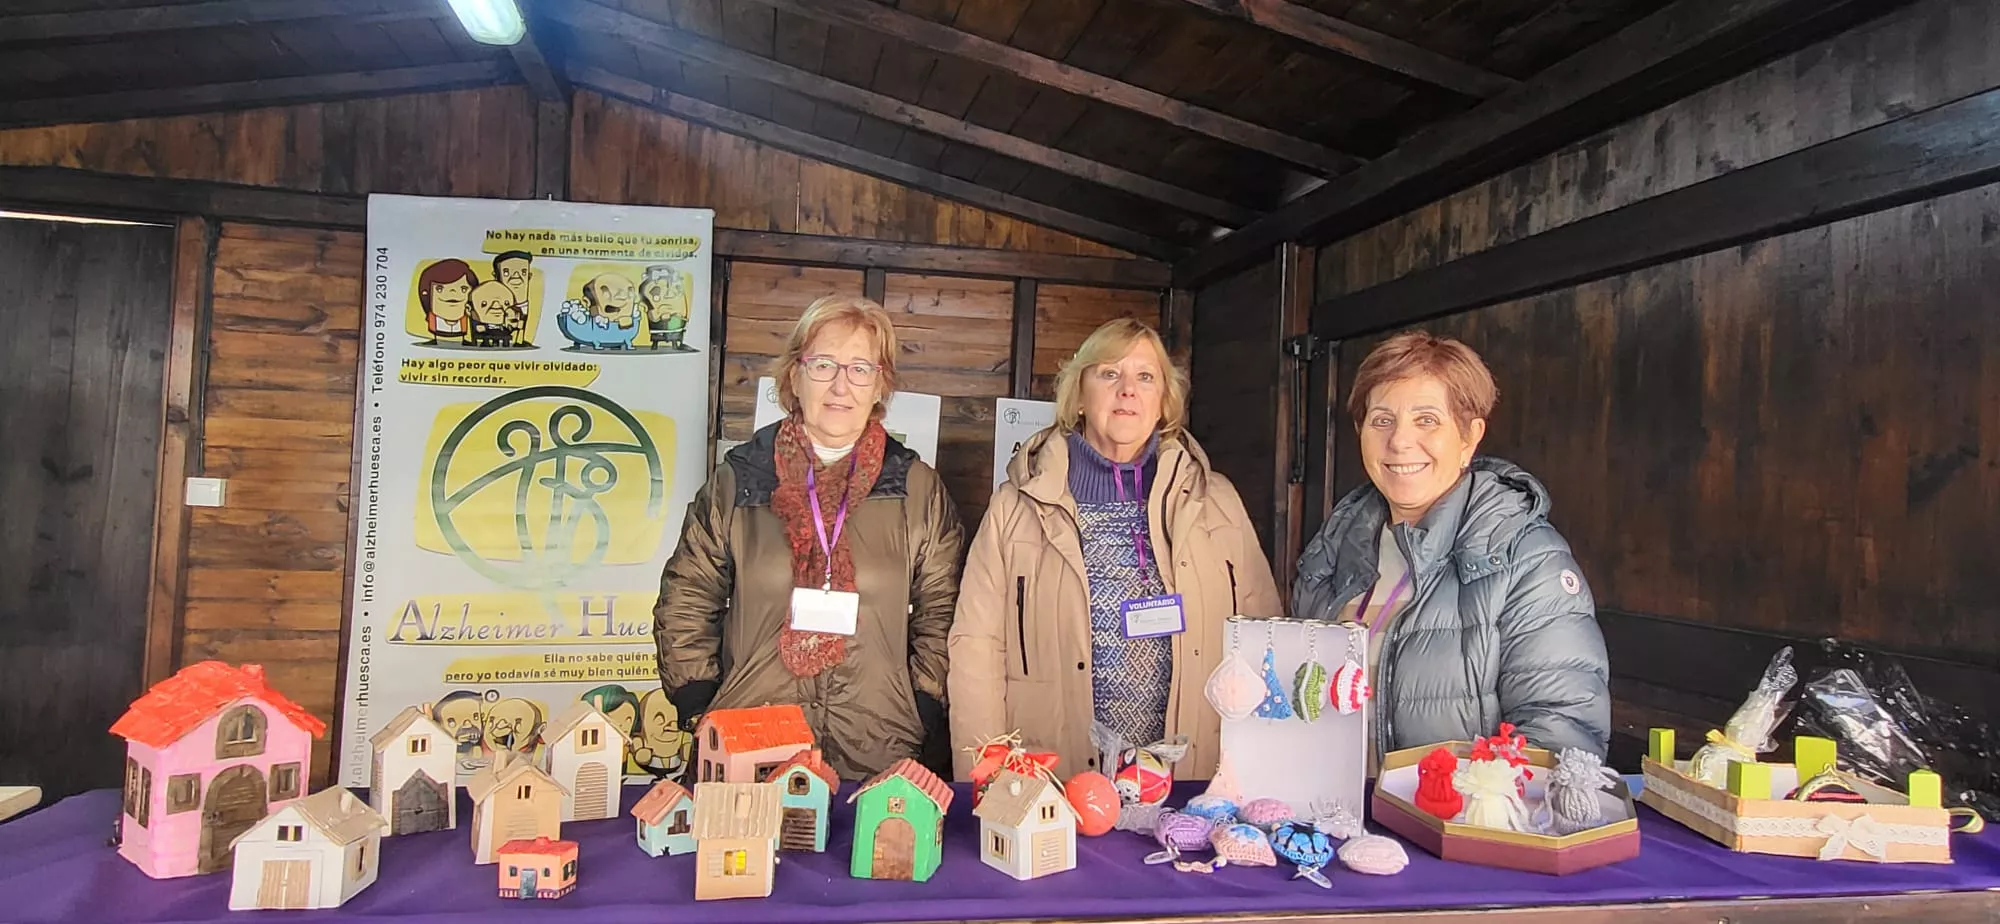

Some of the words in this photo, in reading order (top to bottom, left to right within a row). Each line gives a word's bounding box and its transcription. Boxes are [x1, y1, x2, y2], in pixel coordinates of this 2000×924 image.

[486, 230, 502, 240] No
[505, 231, 525, 242] hay
[529, 231, 556, 241] nada
[560, 233, 583, 243] más
[586, 234, 613, 244] bello
[617, 236, 637, 246] que
[655, 236, 698, 246] sonrisa,
[376, 247, 389, 271] 704
[541, 246, 555, 255] en
[559, 247, 579, 256] una
[582, 248, 635, 257] tormenta
[375, 275, 388, 300] 230
[374, 304, 386, 328] 974
[371, 332, 385, 394] Teléfono
[401, 358, 425, 369] Hay
[428, 359, 455, 371] algo
[458, 362, 485, 371] peor
[489, 363, 511, 372] que
[514, 361, 540, 371] vivir
[543, 361, 597, 372] olvidado:
[400, 372, 428, 382] vivir
[431, 372, 449, 382] sin
[452, 373, 507, 384] recordar.
[361, 415, 382, 603] info@alzheimerhuesca.es
[1128, 598, 1176, 610] VOLUNTARIO
[388, 598, 564, 642] Alzheimer
[577, 595, 650, 637] Hue
[544, 653, 565, 663] Ella
[568, 655, 584, 663] no
[586, 653, 613, 663] sabe
[616, 652, 649, 664] quién
[445, 671, 473, 682] pero
[476, 672, 492, 683] yo
[495, 668, 540, 680] todavía
[544, 668, 556, 678] sé
[559, 669, 585, 680] muy
[588, 667, 613, 677] bien
[616, 666, 649, 678] quién
